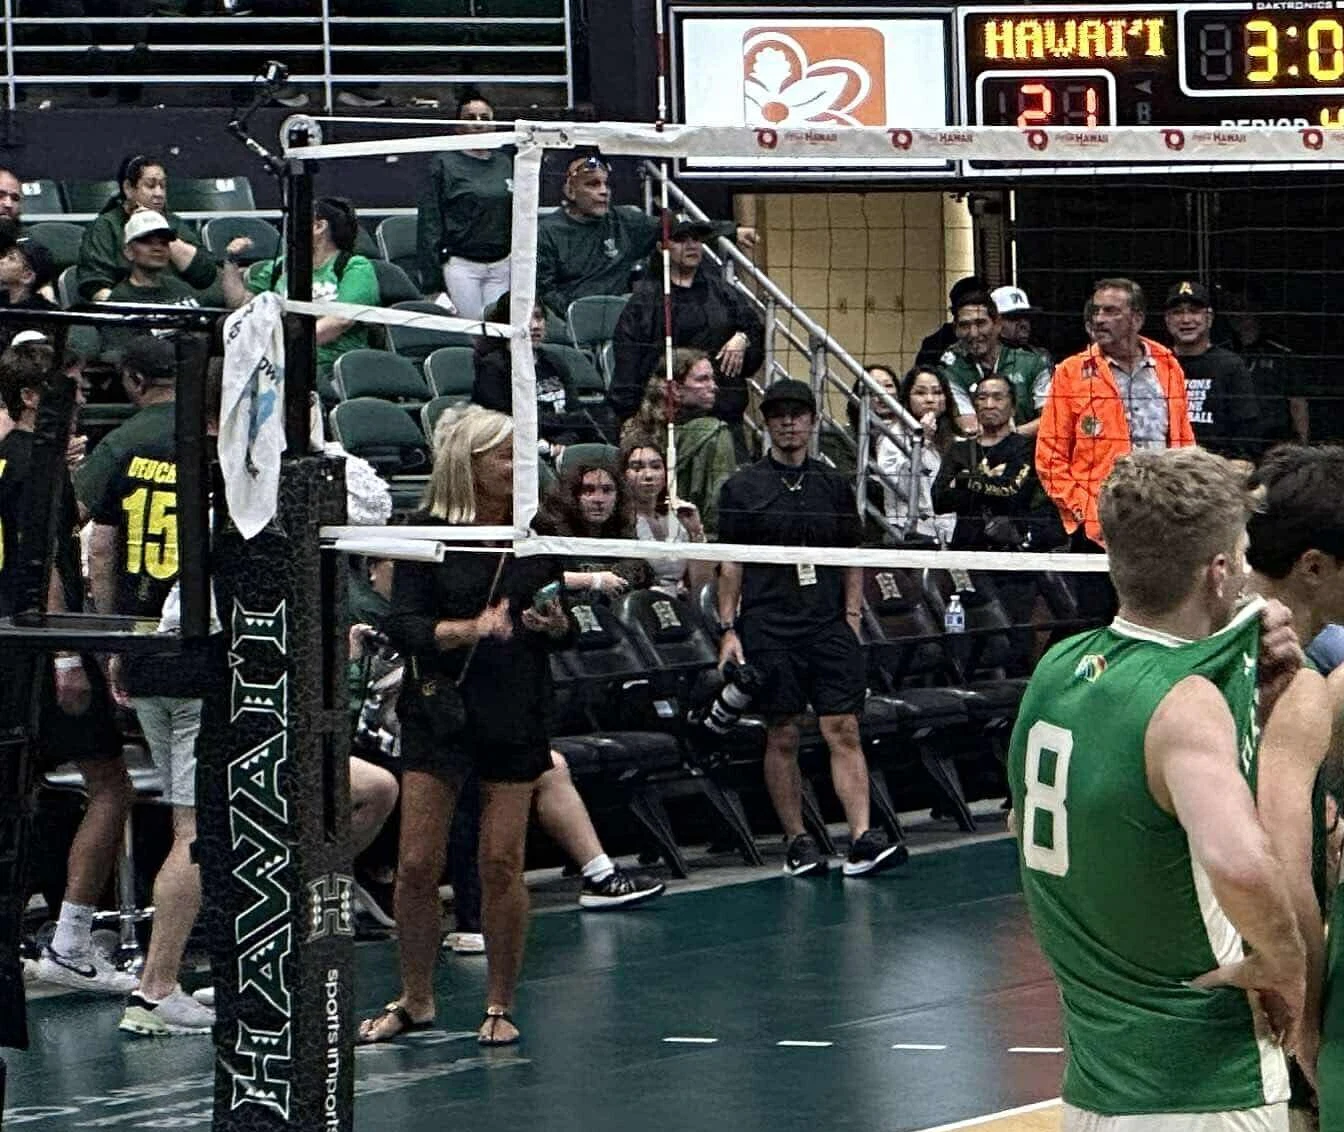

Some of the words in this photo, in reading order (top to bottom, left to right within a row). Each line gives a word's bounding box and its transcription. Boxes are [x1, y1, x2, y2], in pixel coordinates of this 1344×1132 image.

[122, 488, 179, 579] 15
[1021, 719, 1075, 878] 8
[325, 968, 341, 1044] sports
